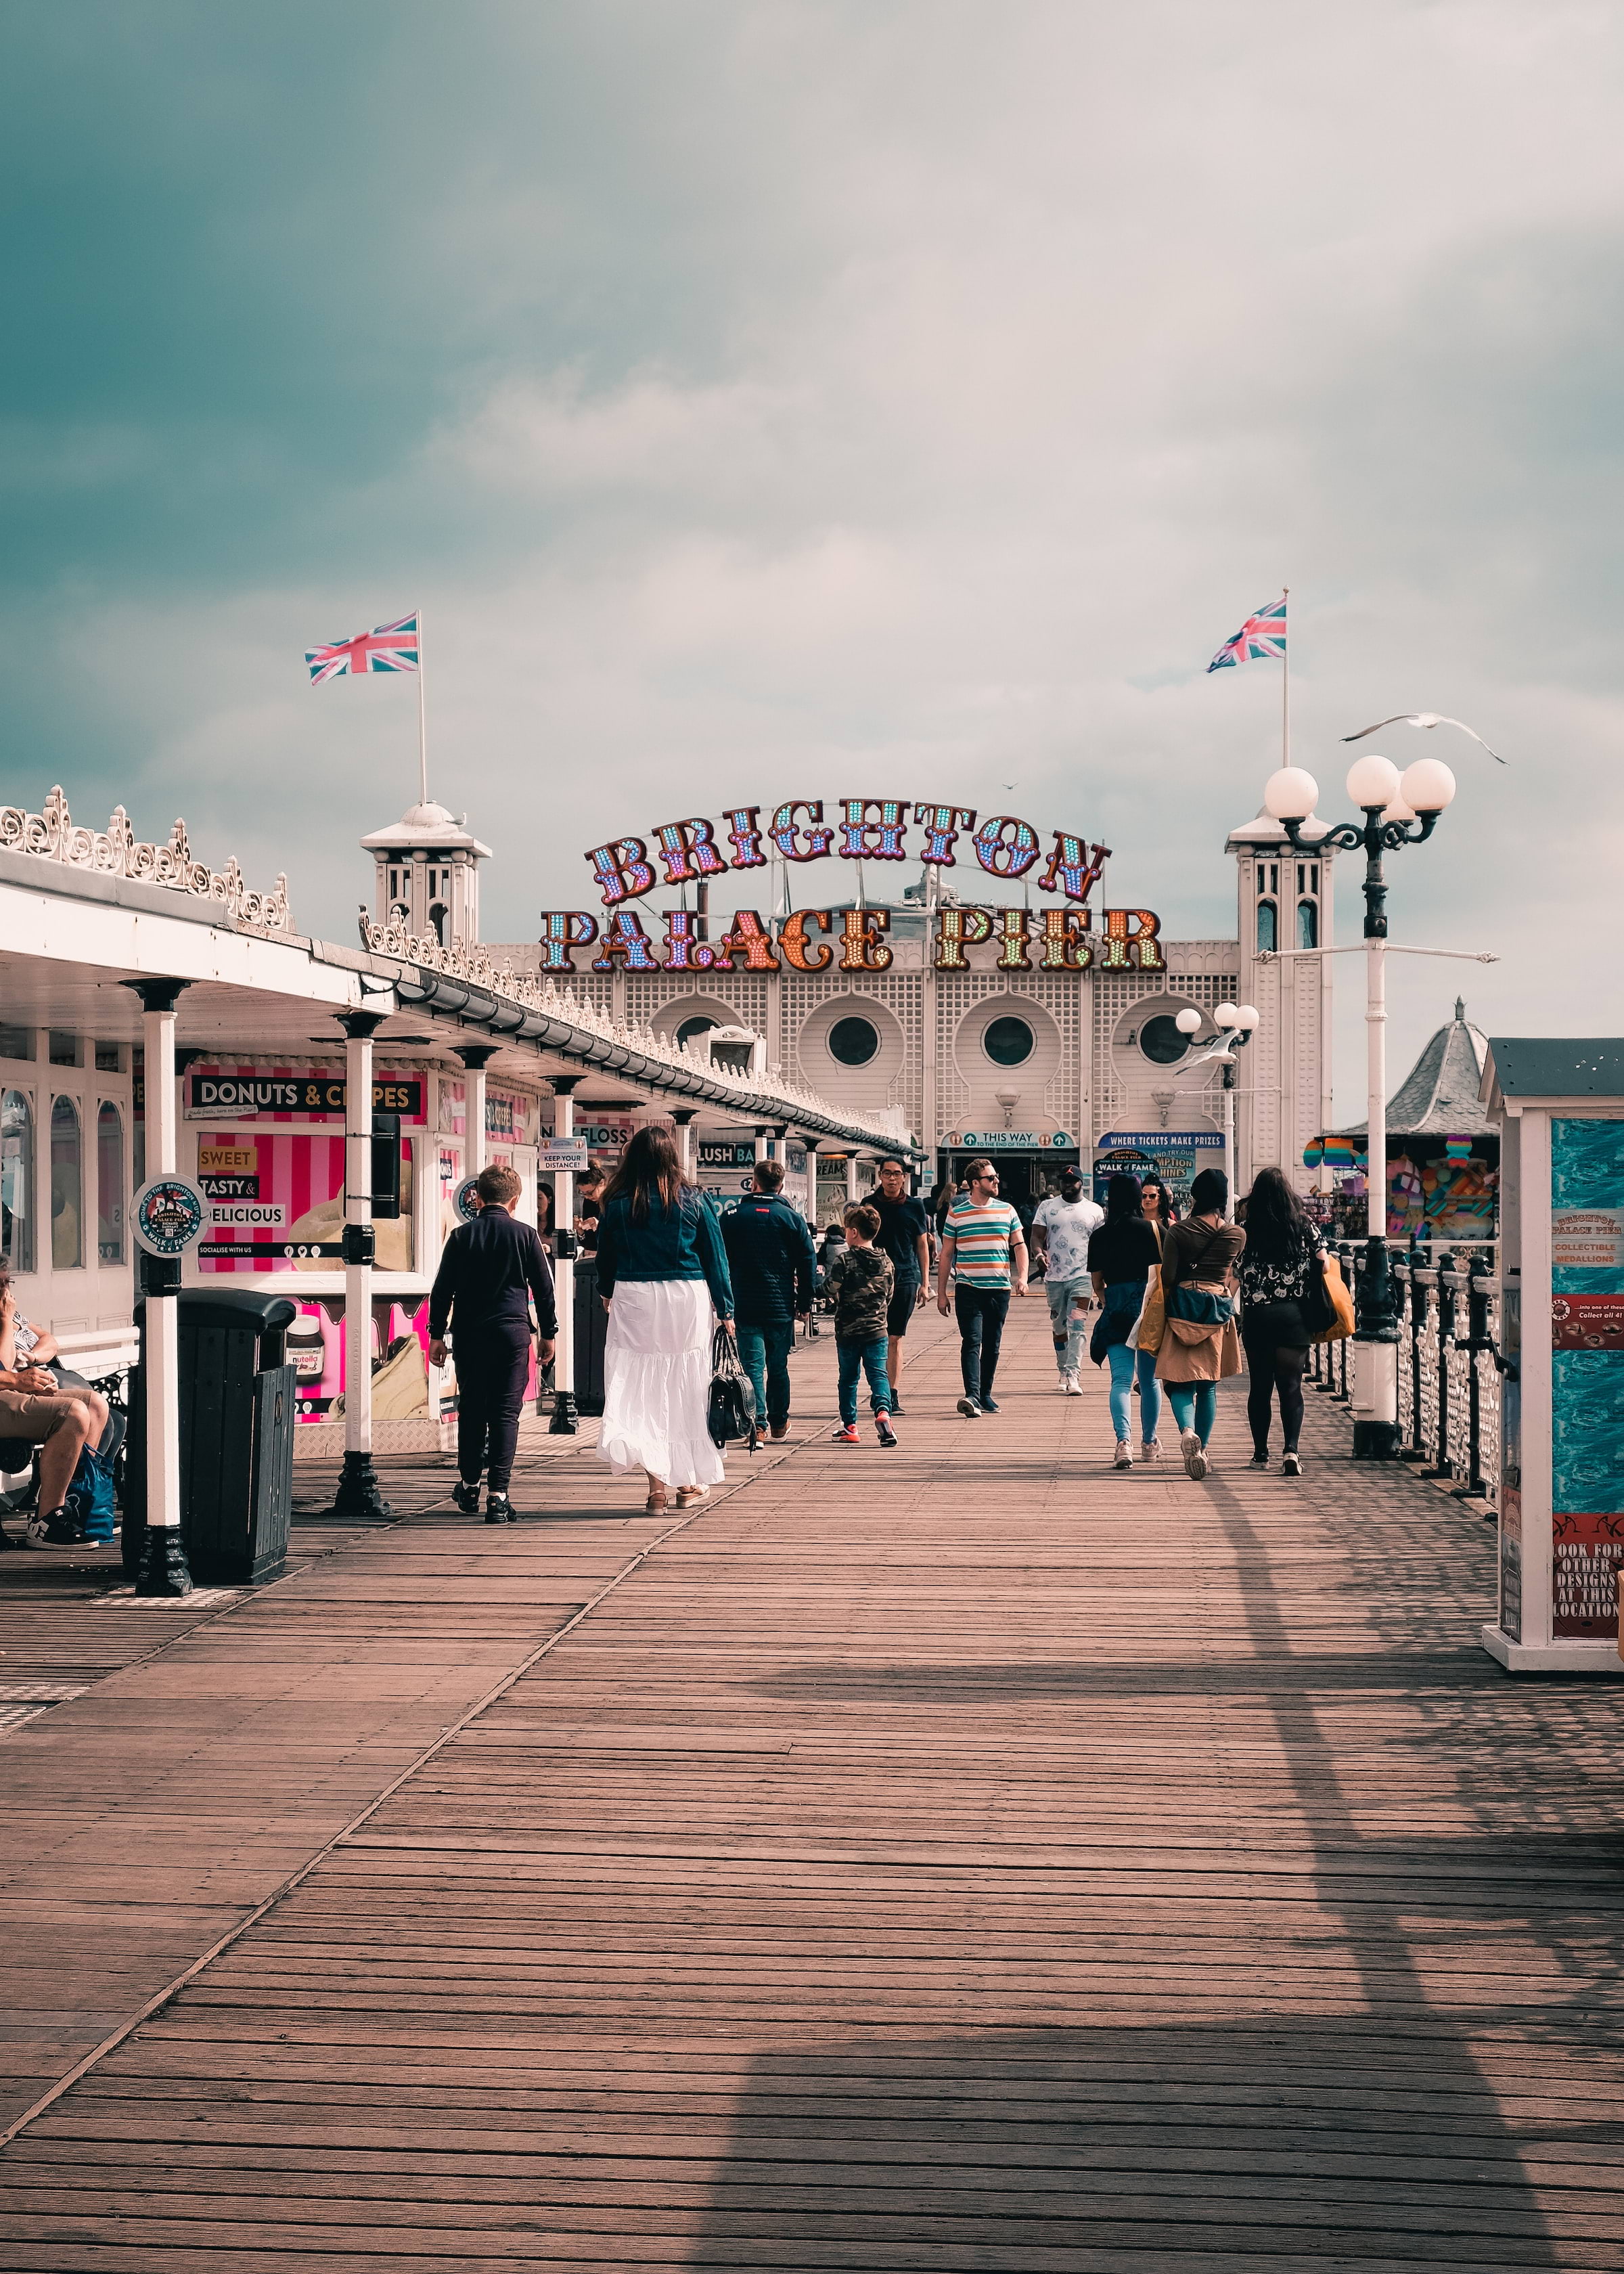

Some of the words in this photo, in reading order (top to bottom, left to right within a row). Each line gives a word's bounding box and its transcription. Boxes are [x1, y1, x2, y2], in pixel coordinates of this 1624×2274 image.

[584, 798, 1112, 904] BRIGHTON
[539, 910, 893, 974] PALACE
[933, 908, 1167, 974] PIER
[202, 1082, 298, 1105] DONUTS
[305, 1085, 321, 1105] &
[326, 1086, 409, 1108] CPES
[581, 1128, 628, 1144] FLOSS
[983, 1133, 1007, 1142] THIS
[1010, 1133, 1033, 1142] WAY
[1110, 1136, 1136, 1145] WHERE
[1139, 1136, 1168, 1145] TICKETS
[1171, 1136, 1192, 1145] MAKE
[1195, 1136, 1220, 1145] PRIZES
[201, 1151, 250, 1165] SWEET
[698, 1149, 732, 1162] LUSH
[737, 1149, 754, 1162] BA
[1124, 1163, 1130, 1172] of
[166, 1183, 195, 1201] BRIGHTON
[200, 1180, 244, 1195] TASTY
[246, 1182, 255, 1195] &
[212, 1208, 281, 1222] ELICIOUS
[1557, 1214, 1616, 1226] BRIGHTON
[1552, 1226, 1592, 1234] PALACE
[1596, 1226, 1622, 1234] PIER
[148, 1232, 166, 1246] WALK
[174, 1231, 194, 1245] FAME
[292, 1355, 318, 1363] nutella
[1594, 1542, 1623, 1558] FOR
[1562, 1557, 1610, 1573] OTHER
[1556, 1573, 1616, 1588] DESIGNS
[1558, 1587, 1575, 1603] AT
[1581, 1587, 1615, 1603] THIS
